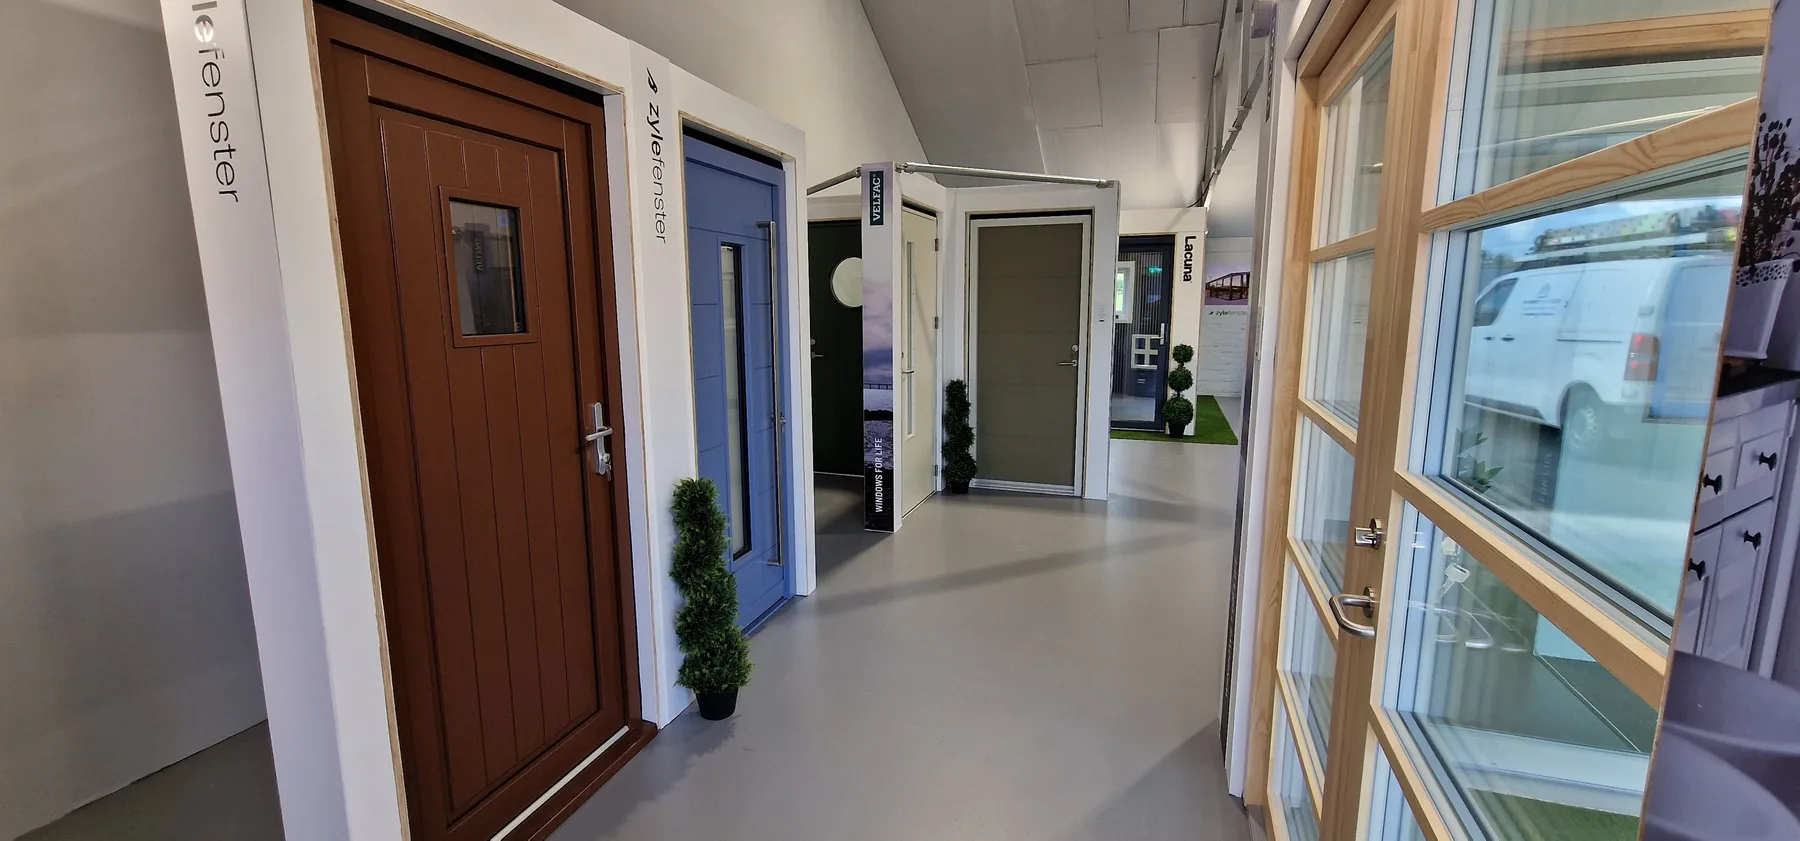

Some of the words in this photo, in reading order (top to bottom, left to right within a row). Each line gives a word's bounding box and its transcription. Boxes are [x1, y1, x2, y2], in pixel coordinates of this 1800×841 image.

[192, 0, 239, 202] lefenster
[646, 101, 667, 244] zylefenster
[872, 177, 881, 222] VELFAC
[1182, 235, 1197, 282] Lacuna
[874, 437, 883, 456] LIFE
[874, 457, 883, 473] FOR
[875, 474, 883, 513] WINDOWS
